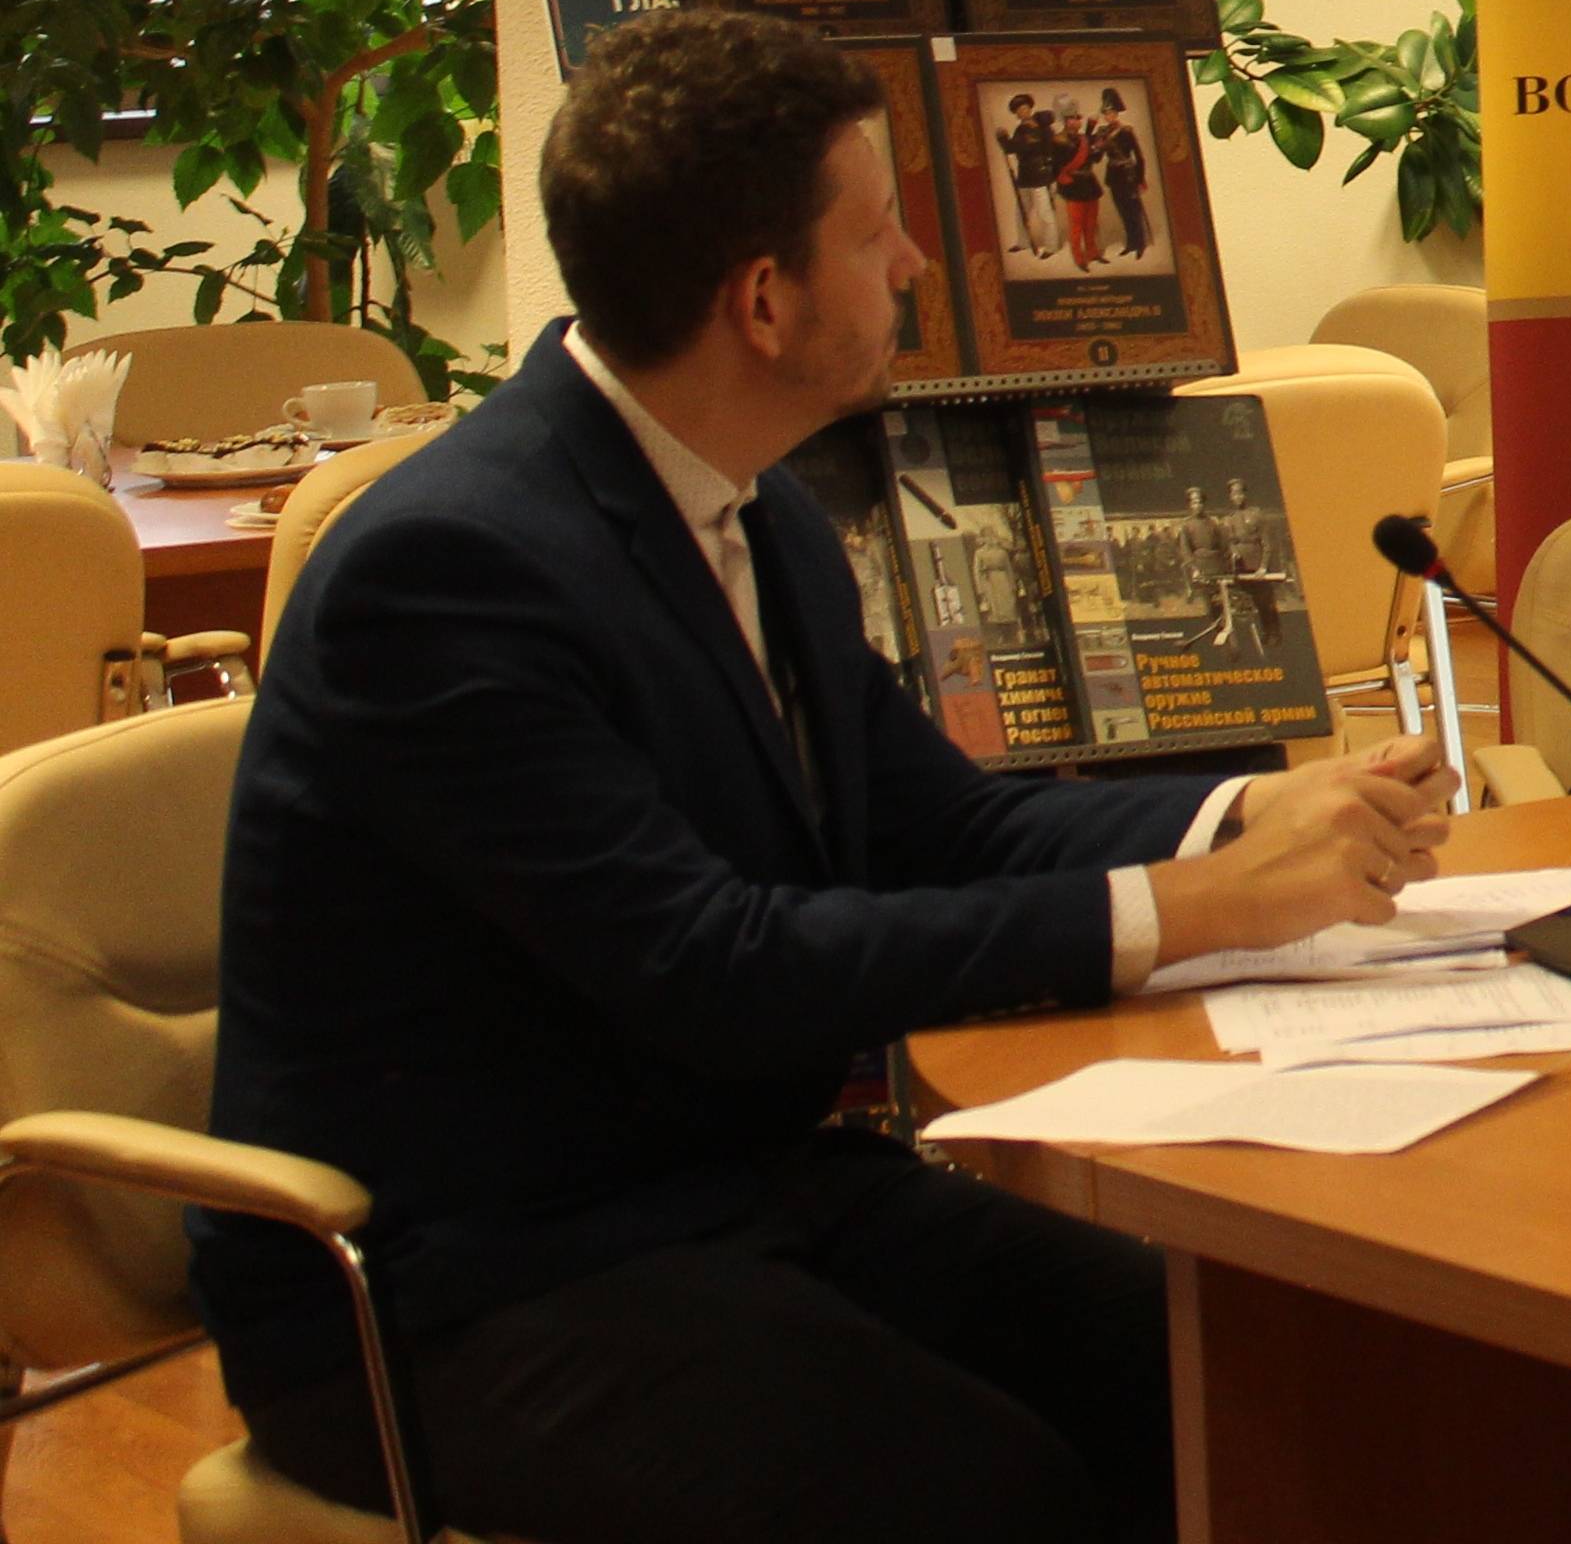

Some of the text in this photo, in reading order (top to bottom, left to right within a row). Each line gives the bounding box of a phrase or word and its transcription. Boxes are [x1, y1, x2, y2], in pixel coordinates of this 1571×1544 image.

[1136, 653, 1200, 673] Ручное
[1141, 667, 1284, 690] автоматическое
[1145, 690, 1213, 711] оружие
[1148, 705, 1317, 730] Российской армии
